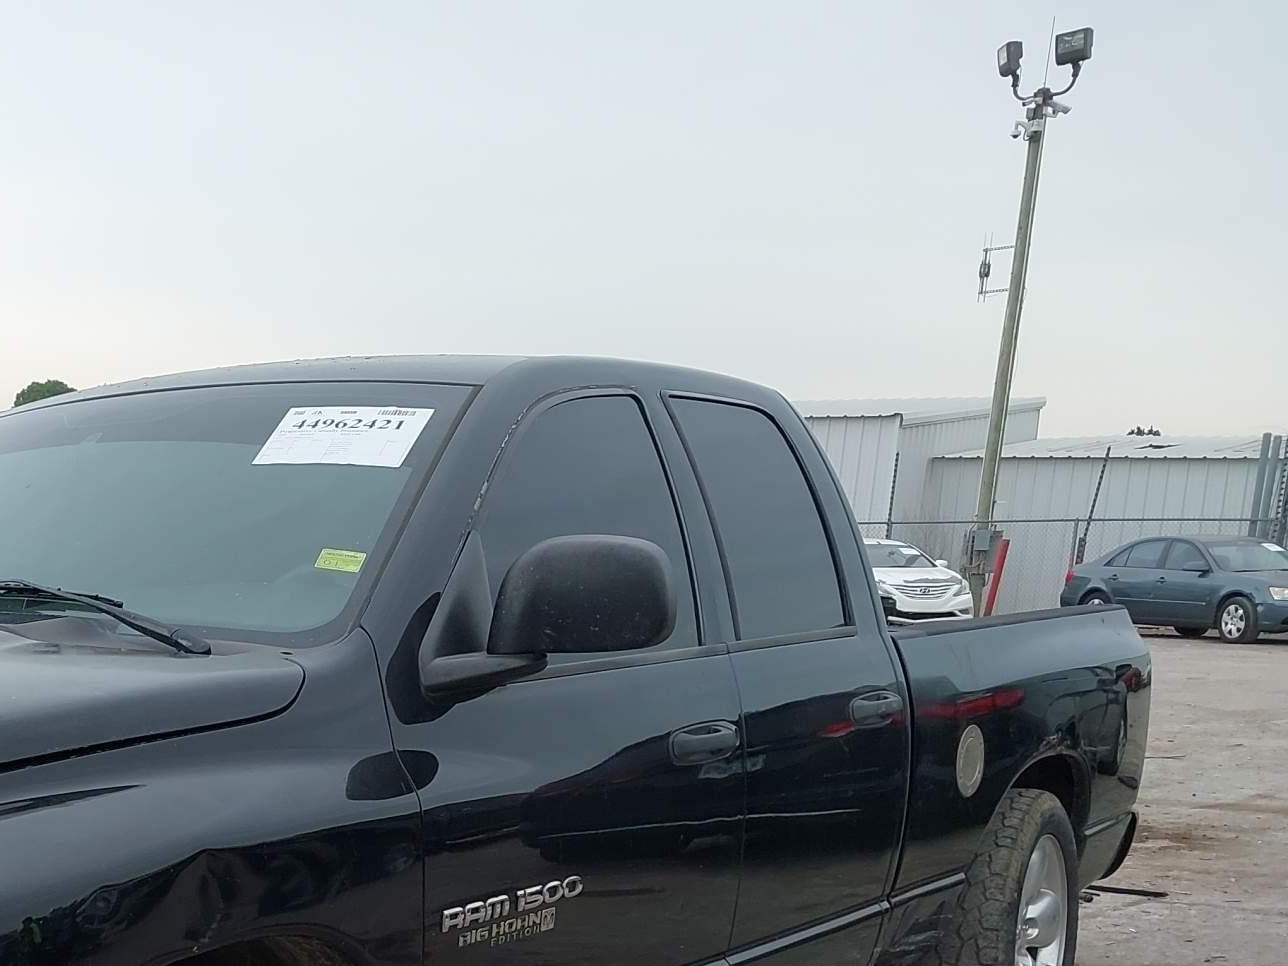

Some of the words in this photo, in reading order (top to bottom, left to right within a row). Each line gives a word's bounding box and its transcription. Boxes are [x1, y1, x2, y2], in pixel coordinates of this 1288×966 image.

[292, 418, 406, 430] 44962421
[441, 894, 510, 933] RAM
[516, 875, 584, 912] 1500
[458, 926, 489, 947] BIG
[491, 910, 542, 937] HORN
[490, 925, 541, 947] EDITION
